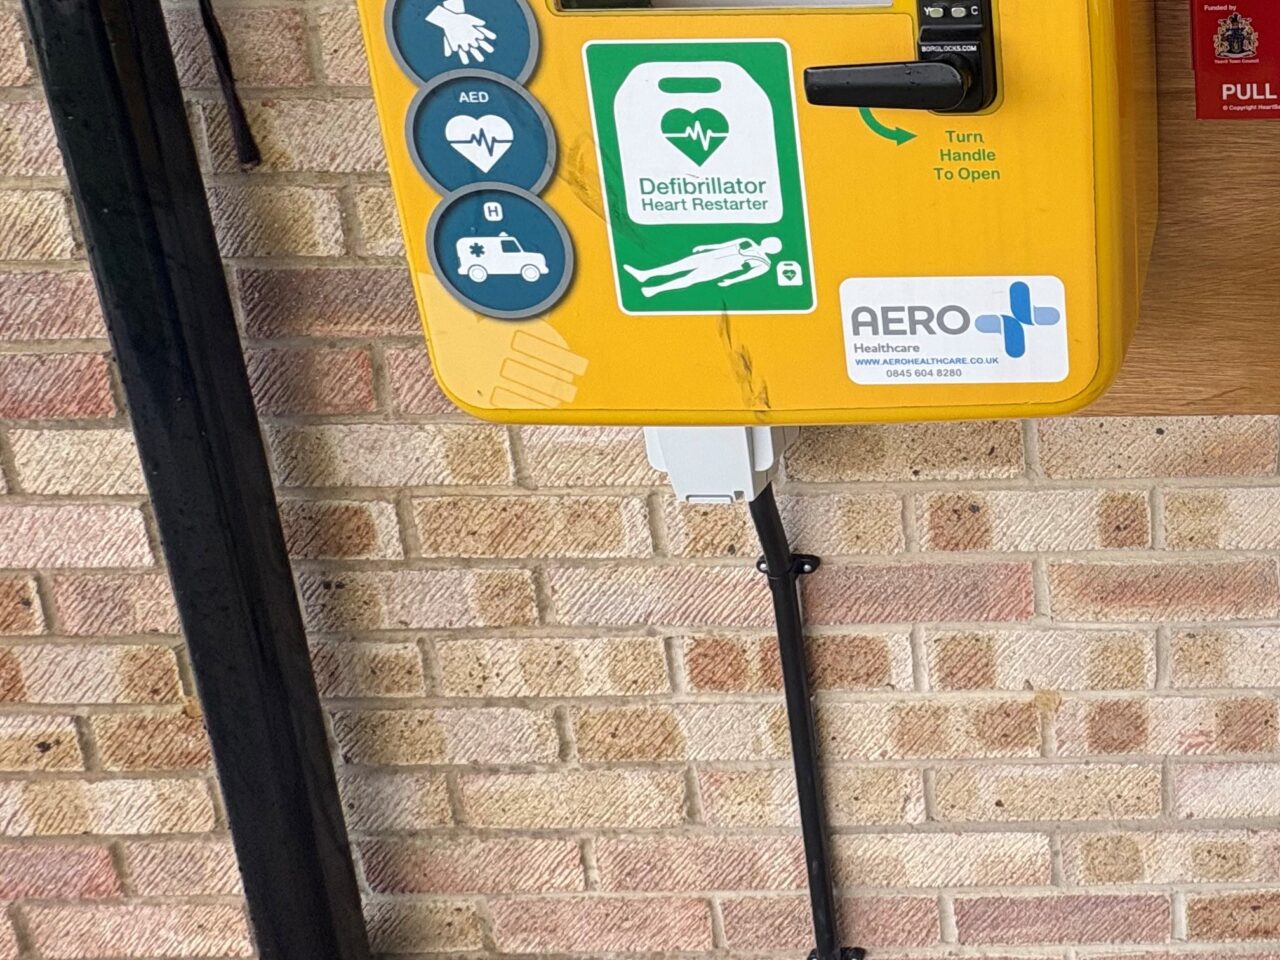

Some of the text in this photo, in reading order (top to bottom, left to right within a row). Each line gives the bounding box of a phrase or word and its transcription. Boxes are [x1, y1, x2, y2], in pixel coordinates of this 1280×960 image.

[924, 6, 978, 15] Y C
[1229, 4, 1236, 12] by
[459, 92, 489, 102] AED
[1223, 83, 1277, 99] PULL
[945, 131, 984, 143] Turn
[940, 149, 995, 161] Handle
[934, 168, 1000, 182] To Open
[640, 177, 766, 194] Defibrillator
[642, 198, 768, 211] Heart Restarter
[488, 204, 499, 218] H
[852, 305, 970, 336] AERO
[854, 343, 919, 353] Healthcare
[855, 357, 998, 365] WWW.AEROHEALTHCARE.CO.UK
[886, 369, 962, 377] 0845 604 8280
